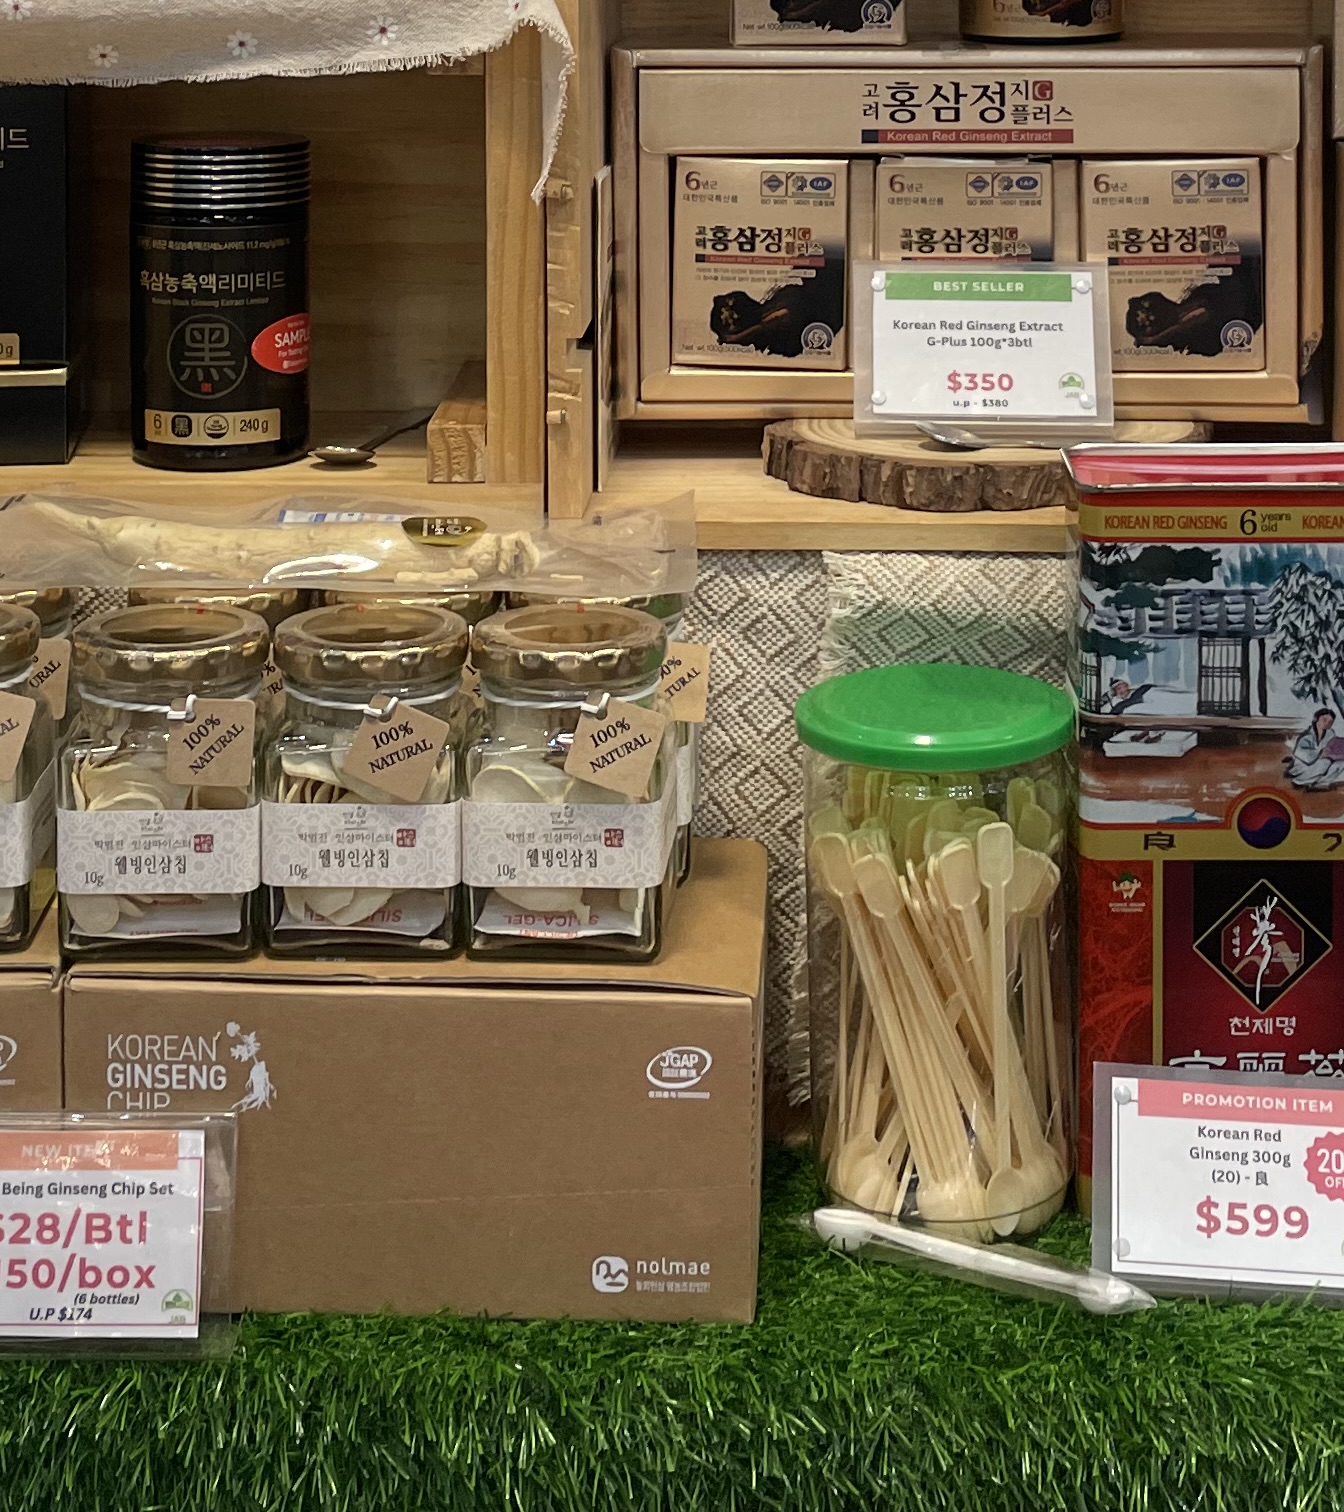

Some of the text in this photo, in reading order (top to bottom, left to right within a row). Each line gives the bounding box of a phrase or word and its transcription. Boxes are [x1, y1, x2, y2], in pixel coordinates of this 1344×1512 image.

[934, 281, 1024, 292] BEST SELLER
[893, 320, 1063, 333] Korean Red Ginseng Extract
[927, 337, 967, 347] G-Plus
[947, 370, 1014, 393] $350
[1104, 509, 1258, 536] KOREAN RED GINSENG 6
[1229, 1016, 1297, 1036] 천제명
[1182, 1092, 1333, 1114] PROMOTION ITEM
[1197, 1126, 1281, 1142] Korean Red
[1190, 1146, 1291, 1168] Ginseng 300g
[1212, 1170, 1269, 1186] (20) 良
[2, 1182, 43, 1198] Being
[47, 1181, 107, 1198] Ginseng
[111, 1181, 145, 1198] Chip
[149, 1182, 174, 1195] Set
[1196, 1195, 1310, 1240] $599
[636, 1257, 710, 1275] nolmae
